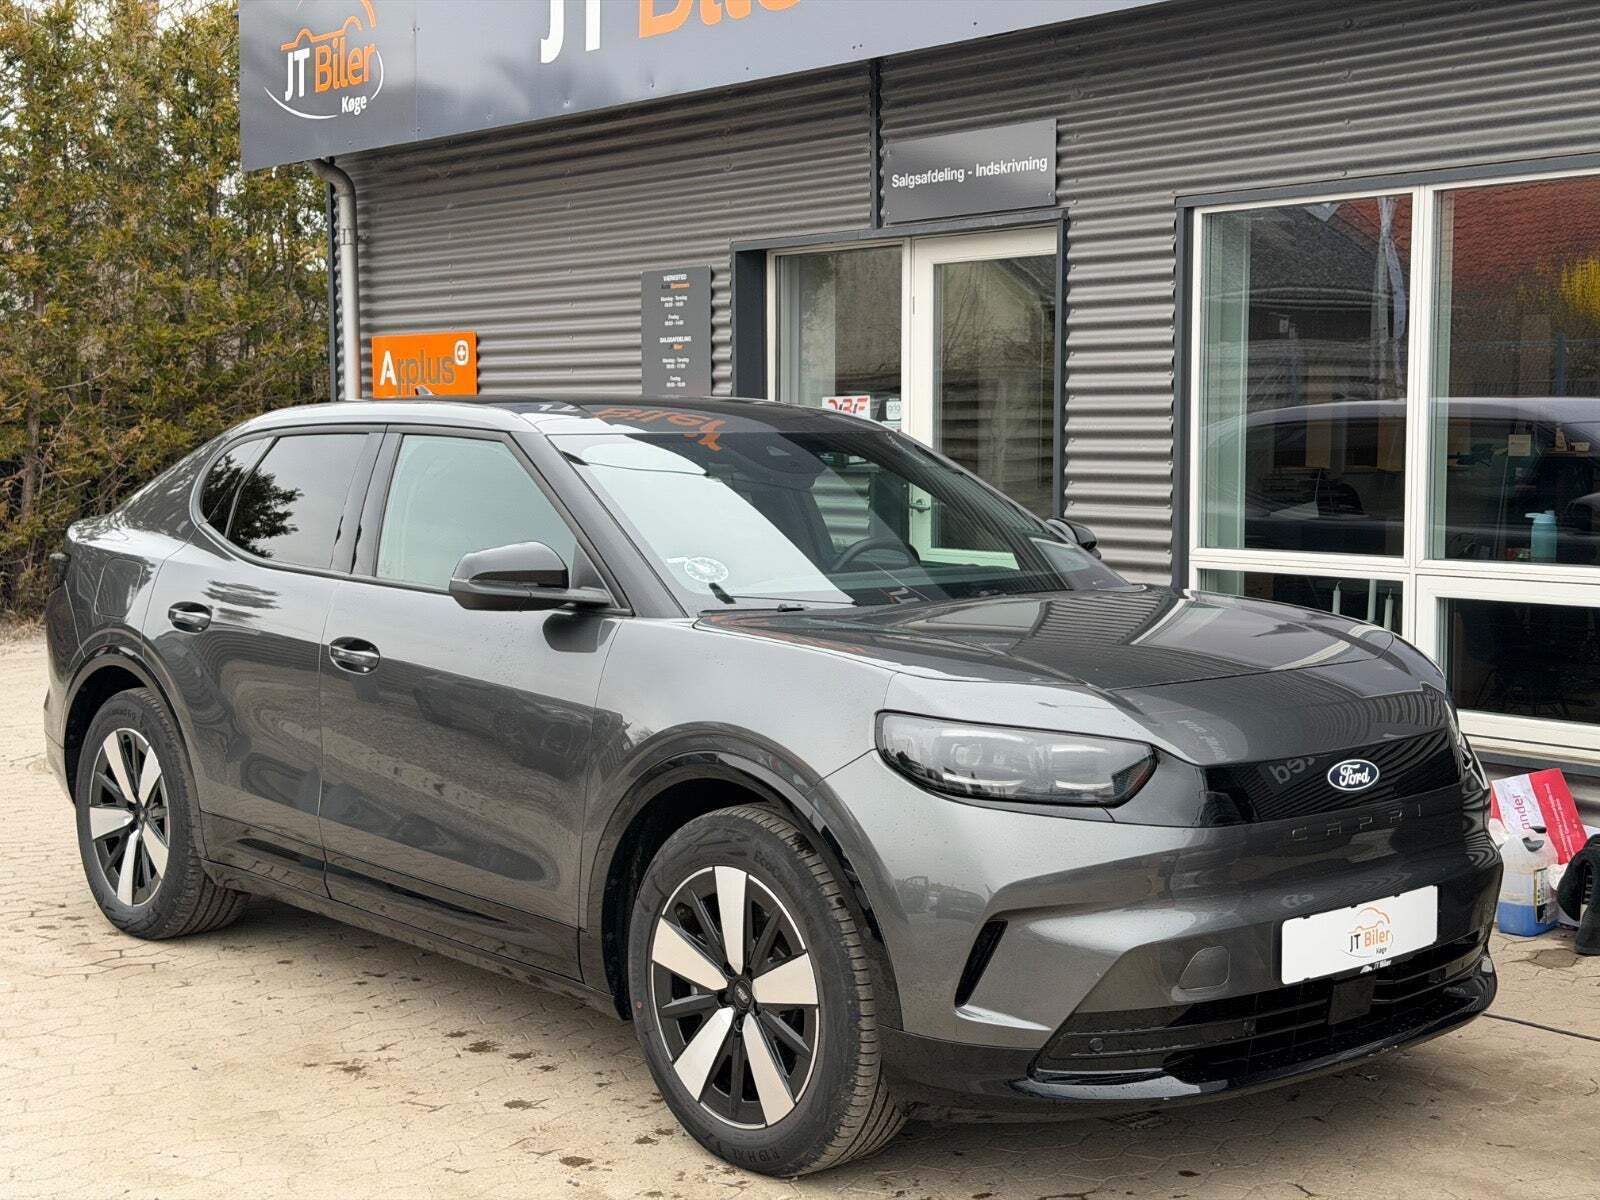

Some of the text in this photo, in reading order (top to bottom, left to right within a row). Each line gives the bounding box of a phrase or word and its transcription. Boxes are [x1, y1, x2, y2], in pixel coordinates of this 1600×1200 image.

[284, 37, 376, 102] JT Biler
[341, 95, 367, 116] Køge
[891, 166, 965, 189] Salgsafdeling
[975, 156, 1048, 178] Indskrivning
[1339, 763, 1371, 787] Ford
[1349, 928, 1391, 953] JT Biler
